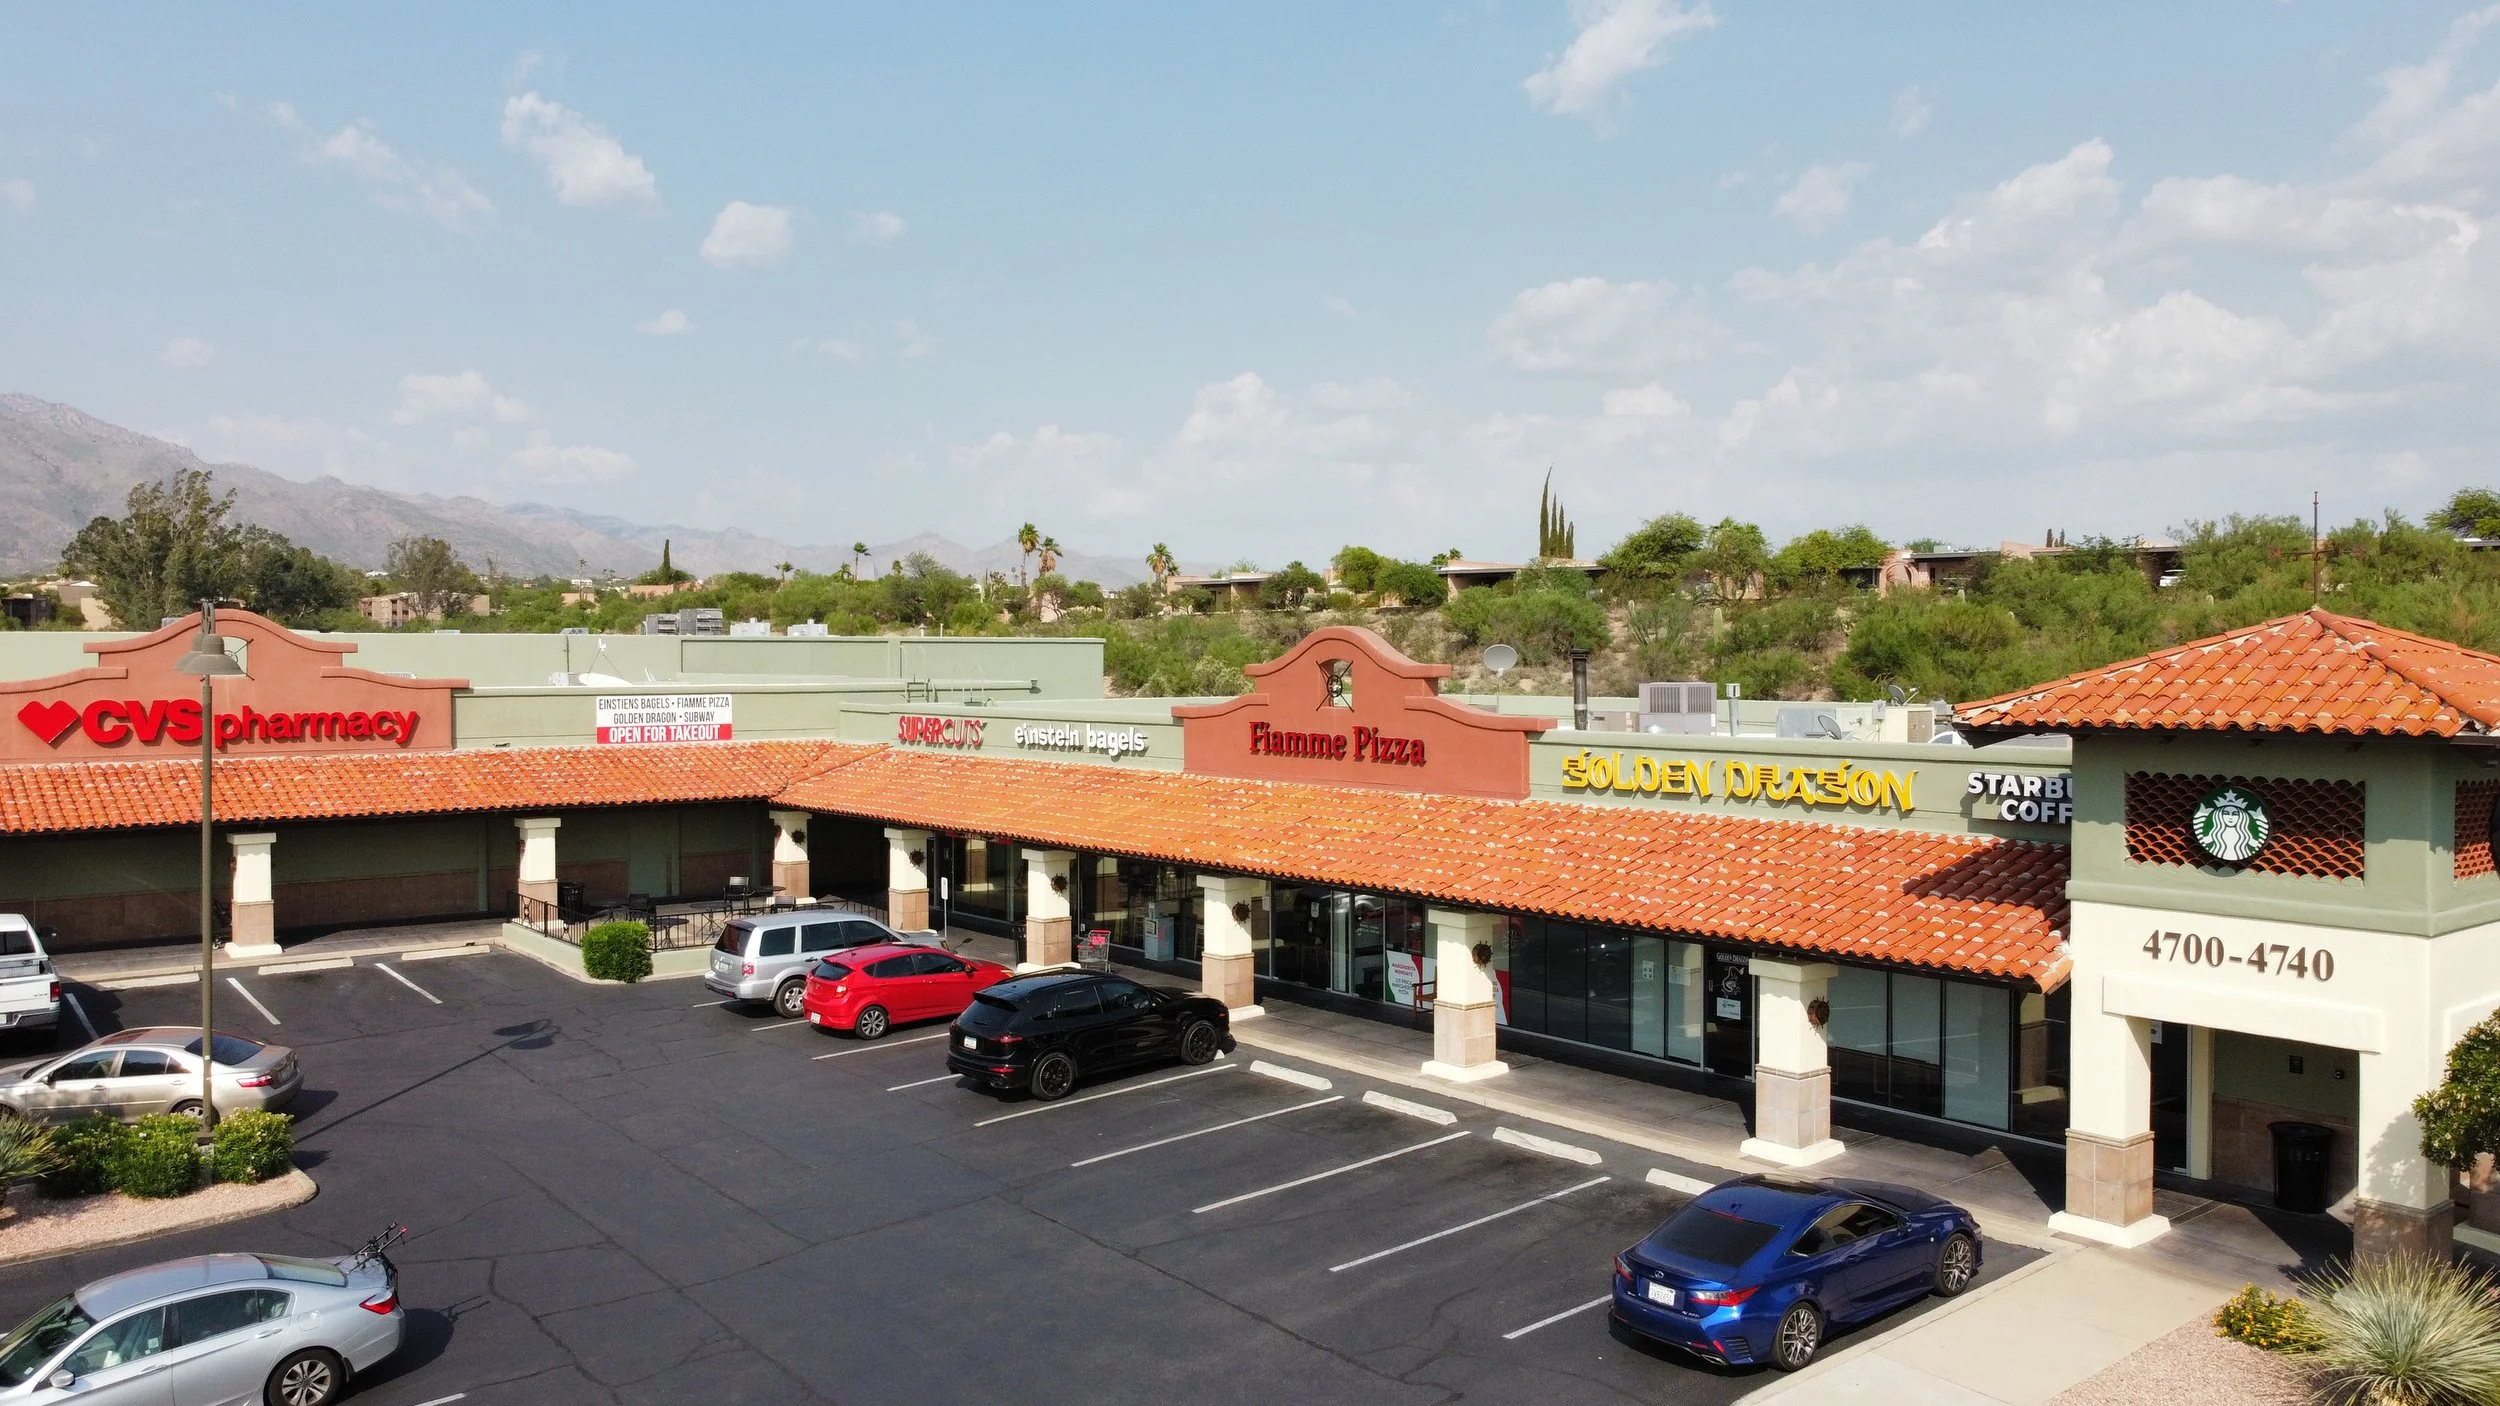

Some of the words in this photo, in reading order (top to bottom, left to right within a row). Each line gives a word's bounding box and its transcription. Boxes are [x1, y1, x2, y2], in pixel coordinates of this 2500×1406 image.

[599, 698, 639, 710] EINSTIENS
[641, 698, 670, 709] BAGELS
[677, 697, 707, 708] FIAMME
[709, 697, 730, 708] PIZZA
[614, 712, 644, 724] GOLDEN
[646, 712, 677, 724] DRAGON
[684, 711, 715, 723] SUBWAY
[82, 699, 203, 743] CVS
[215, 705, 418, 747] pharmacy
[609, 727, 641, 743] OPEN
[644, 726, 667, 742] FOR
[669, 725, 721, 741] TAKEOUT
[898, 715, 983, 746] SUPERCUTS
[1014, 722, 1080, 747] einstein
[1086, 723, 1146, 756] bagels
[1249, 721, 1348, 758] Fiamme
[1352, 726, 1427, 765] Pizza
[1562, 748, 1714, 798] GOLDEN
[1724, 759, 1918, 812] DRAGON
[2001, 799, 2072, 823] COFF
[2142, 929, 2335, 982] 4700-4740
